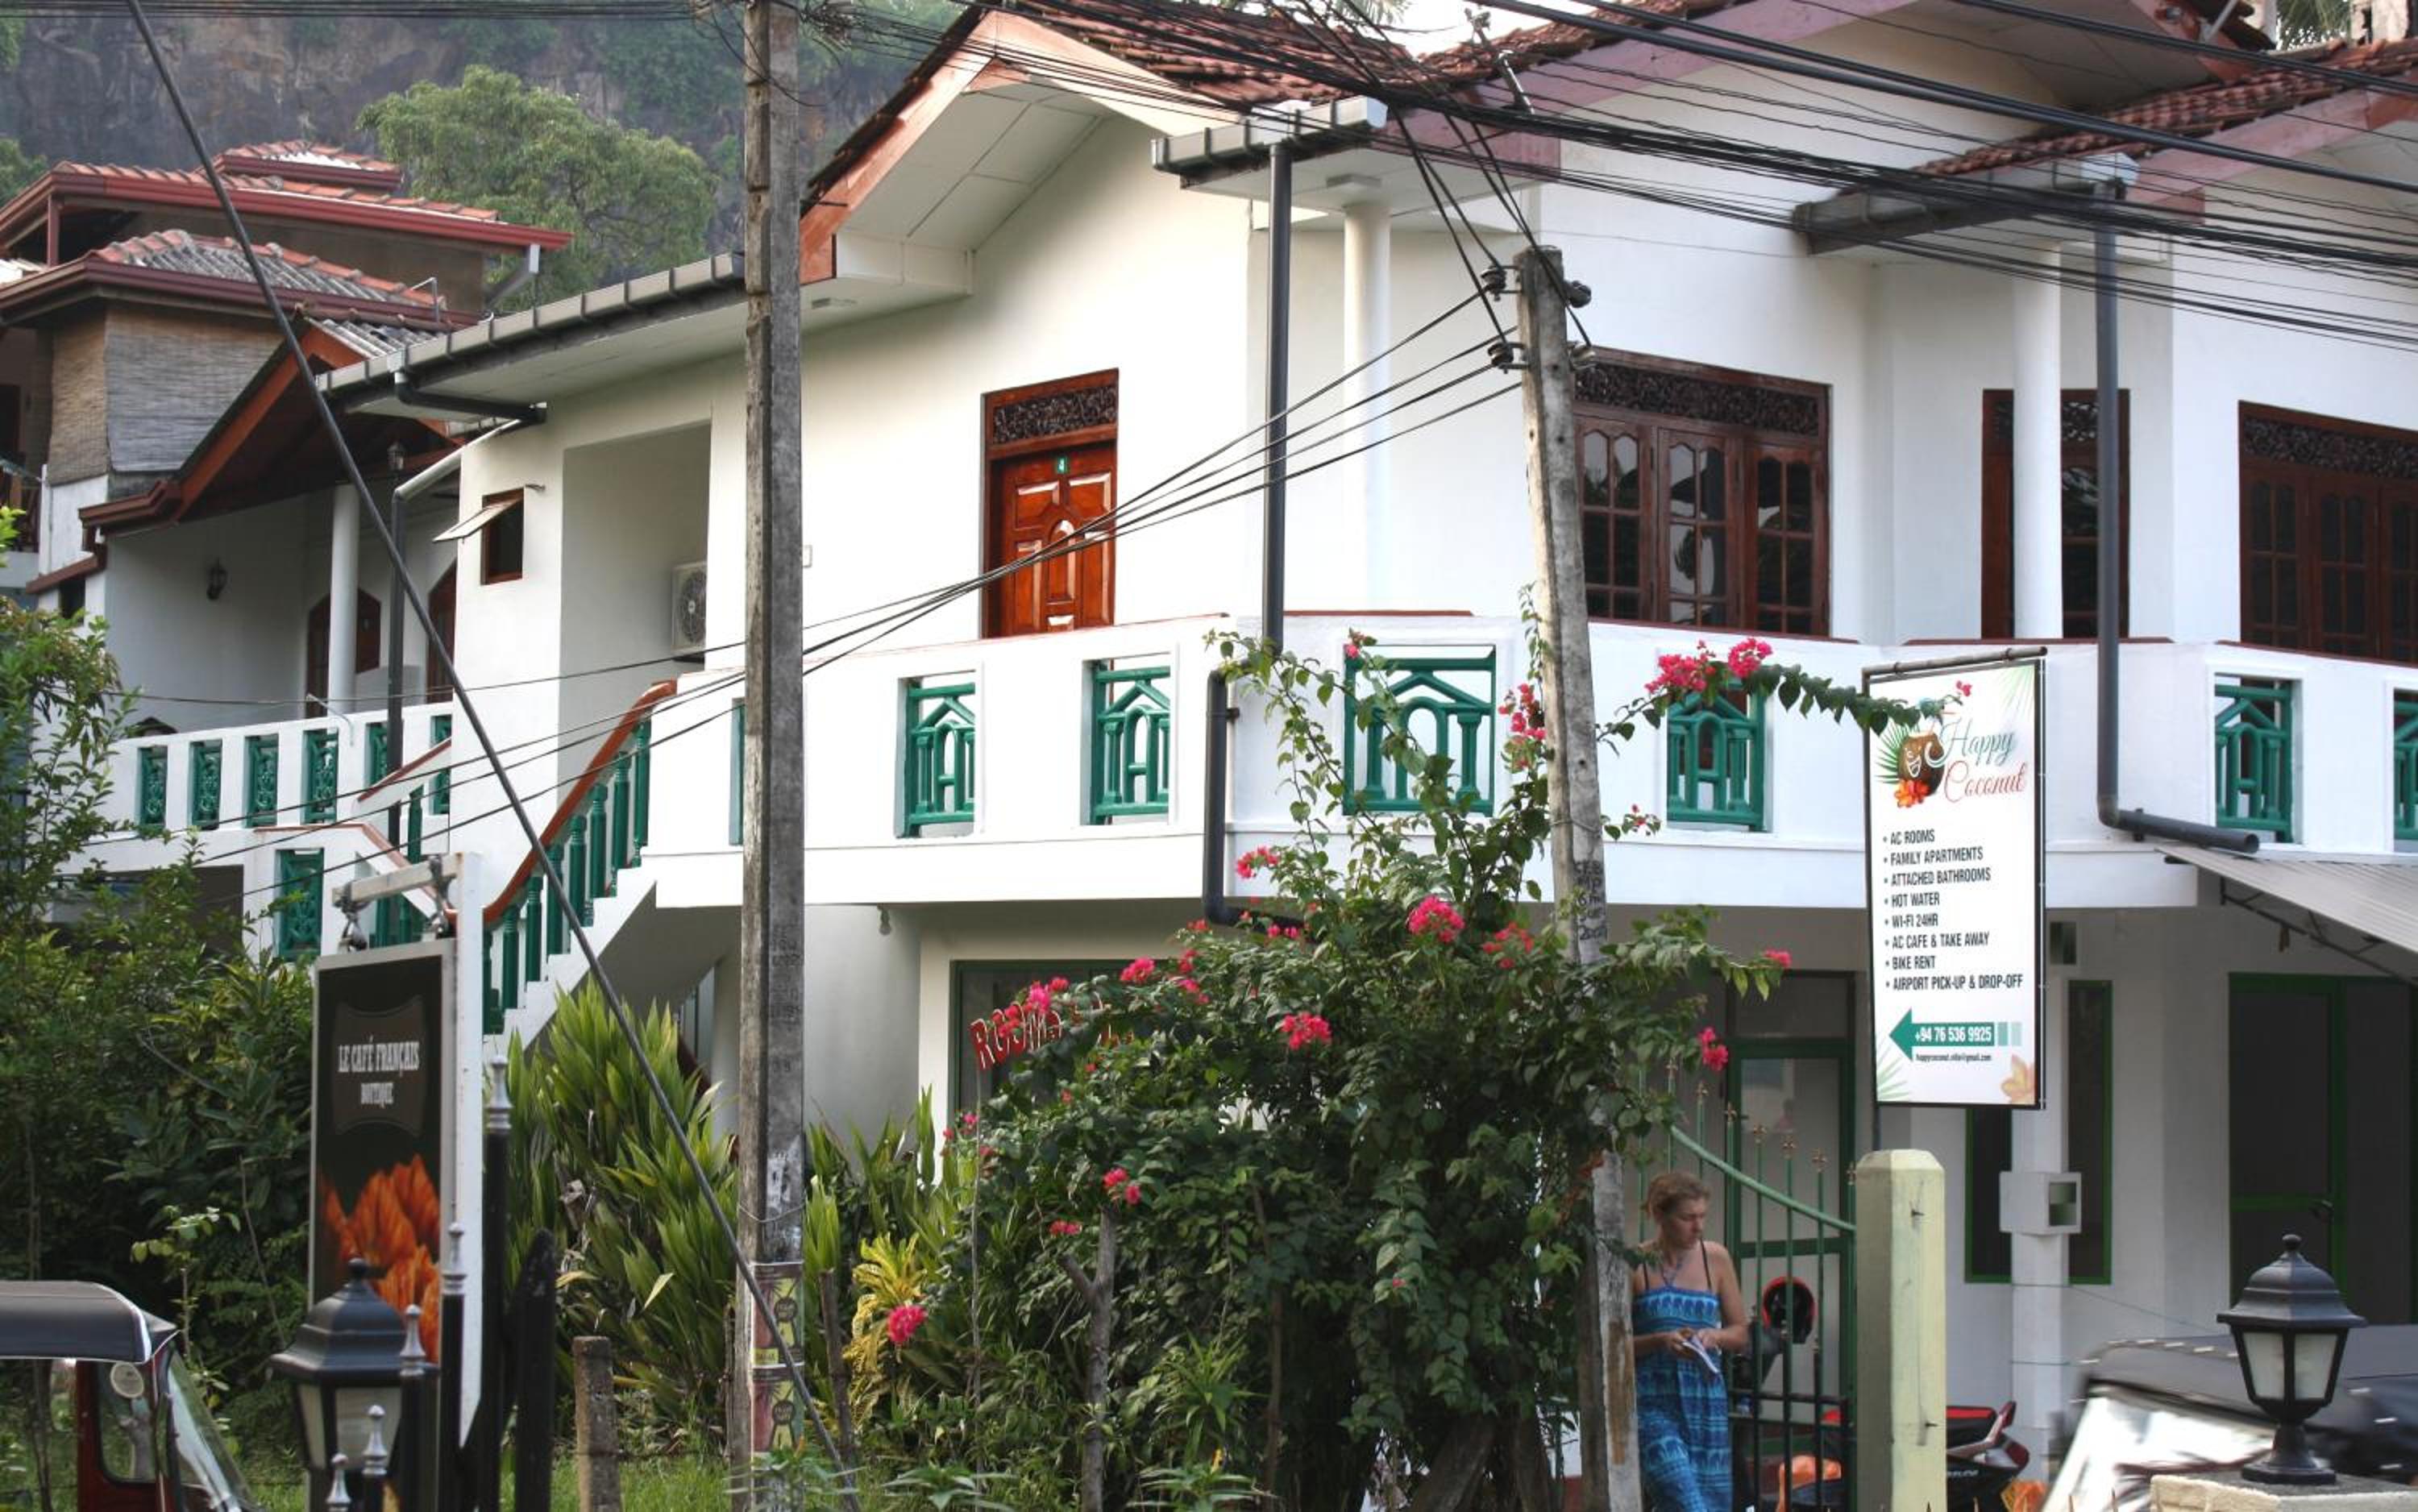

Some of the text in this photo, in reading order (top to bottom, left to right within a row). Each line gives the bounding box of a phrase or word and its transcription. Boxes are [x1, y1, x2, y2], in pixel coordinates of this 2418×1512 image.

[1928, 716, 2016, 766] Happy
[1944, 760, 2027, 803] Coconut
[1890, 829, 1935, 845] AC ROOMS
[1890, 846, 1984, 866] FAMILY APARTMENTS
[1890, 867, 1992, 887] ATTACHED BATHROOMS
[1891, 891, 1940, 908] HOT WATER
[1892, 913, 1938, 928] WI-FI 24HR
[1892, 932, 1990, 949] AC CAFE & TAKE AWAY
[1892, 955, 1936, 970] BIKE RENT
[1892, 974, 2023, 991] AIRPORT PICK-UP & DROP-OFF
[1915, 1026, 1992, 1042] +94 76 536 9925
[339, 1035, 419, 1078] LE CAFÉ FRANÇAIS
